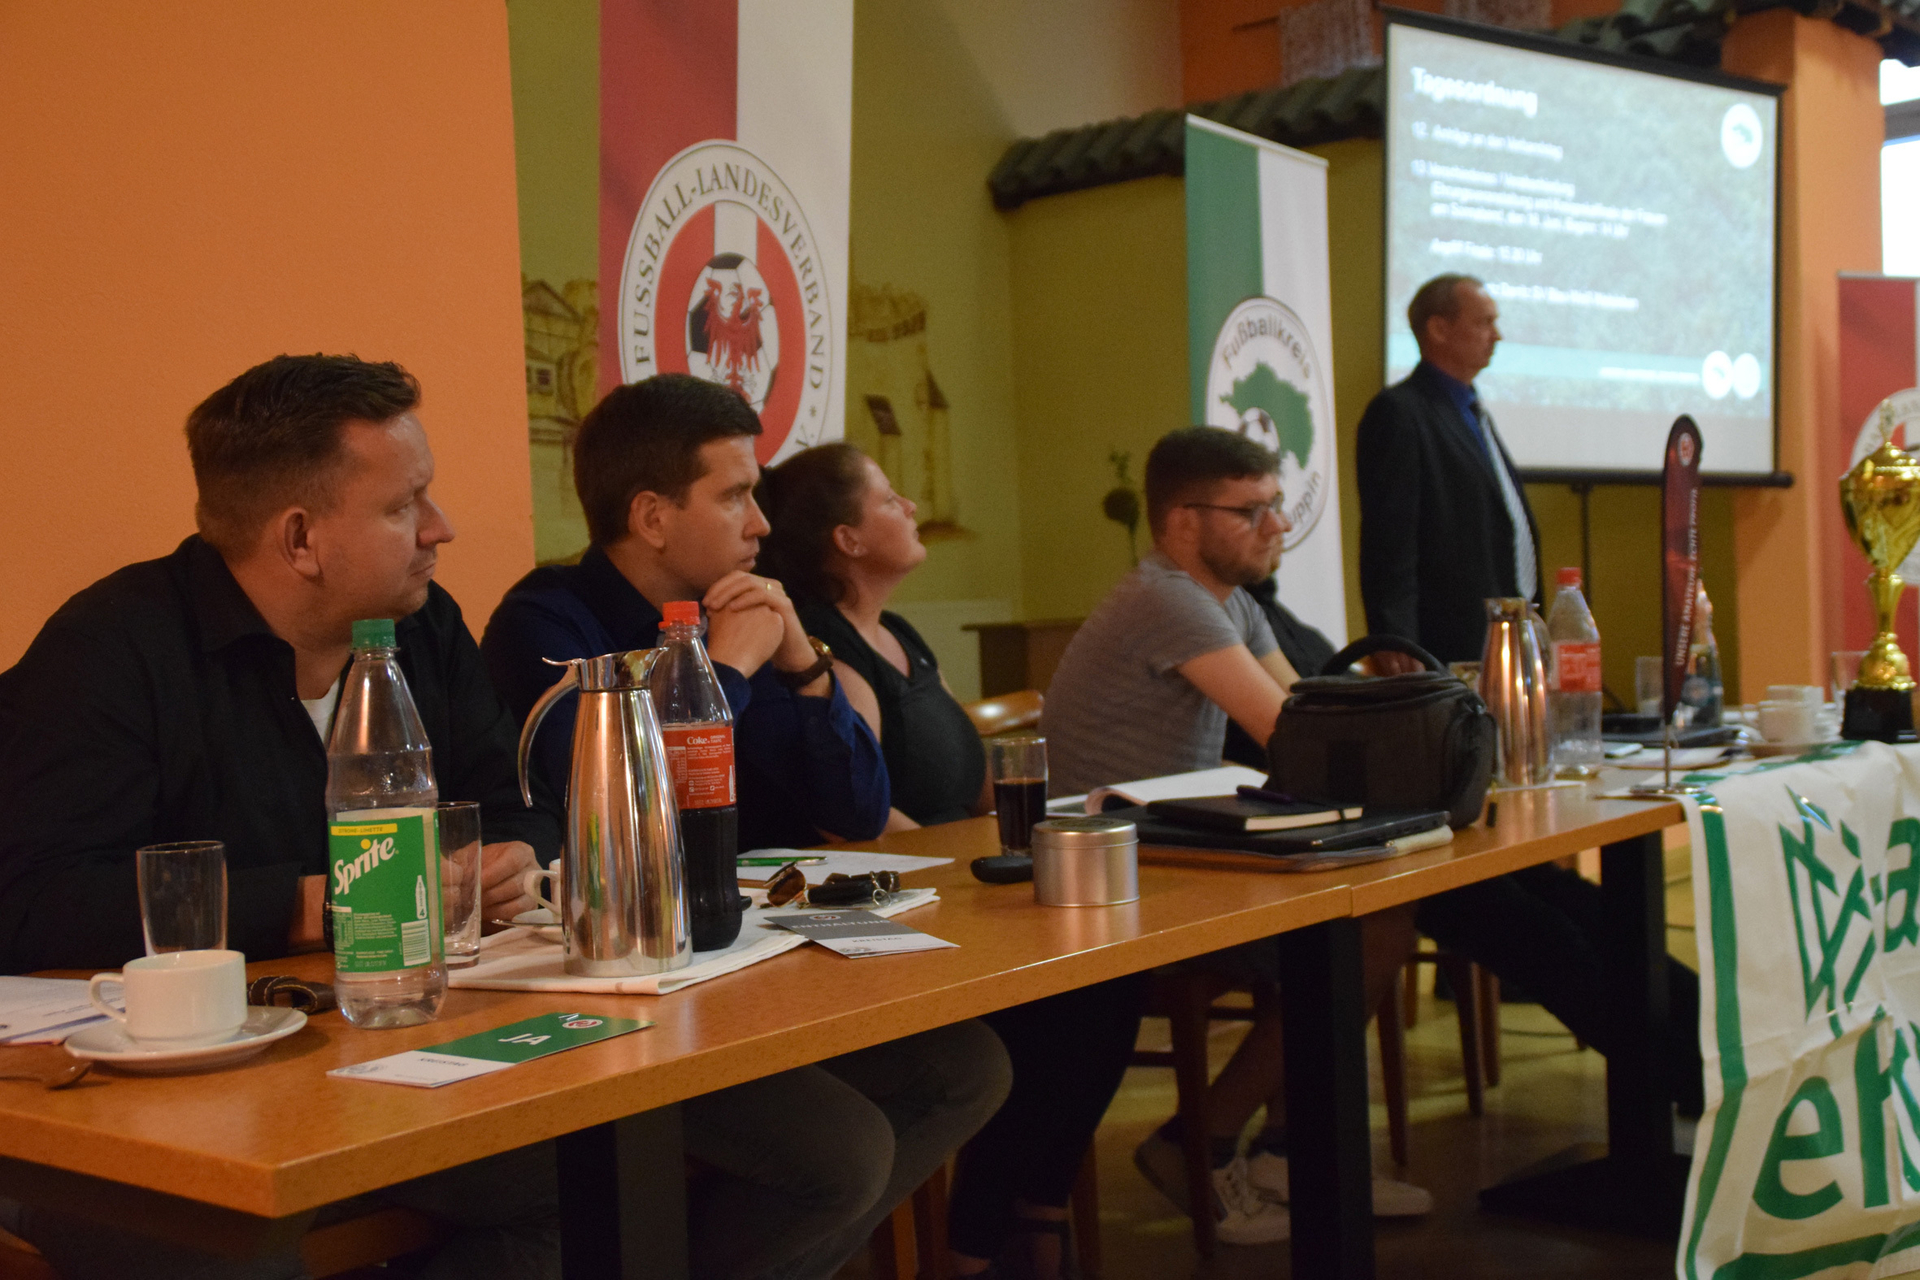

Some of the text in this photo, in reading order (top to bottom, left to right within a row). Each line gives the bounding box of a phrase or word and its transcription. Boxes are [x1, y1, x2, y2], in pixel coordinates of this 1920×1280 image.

[1222, 314, 1312, 380] Fußballkreis
[1288, 470, 1322, 525] ppin
[687, 736, 708, 745] Coke
[334, 837, 396, 896] Sprite
[791, 919, 891, 929] ENTHALTUNG
[498, 1033, 552, 1046] JA
